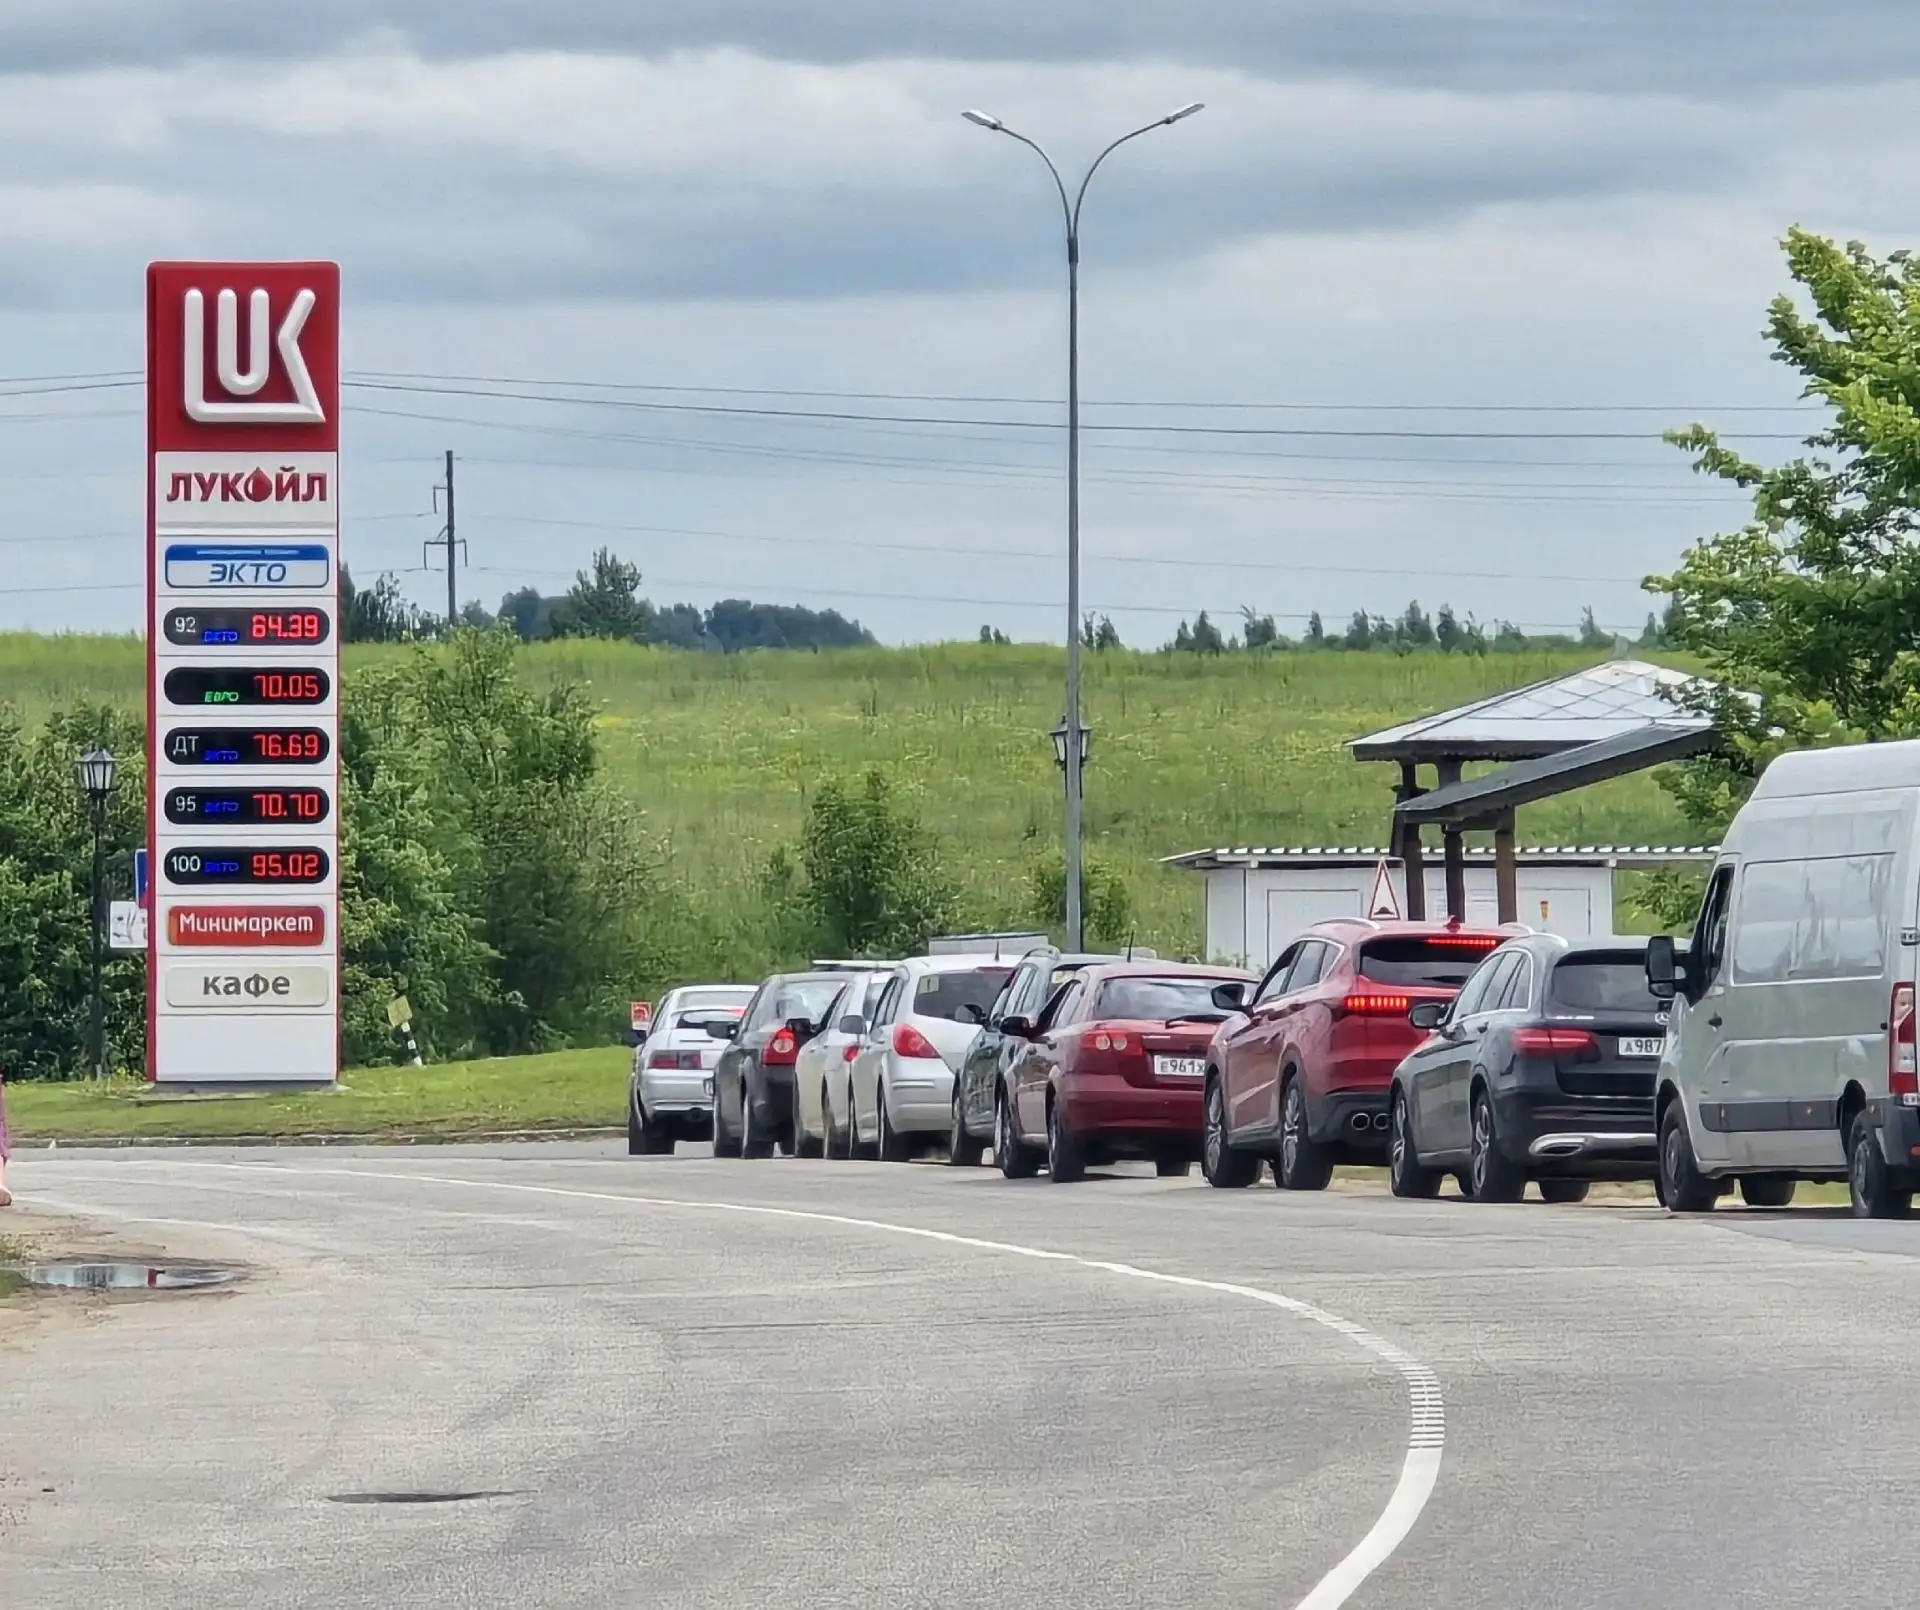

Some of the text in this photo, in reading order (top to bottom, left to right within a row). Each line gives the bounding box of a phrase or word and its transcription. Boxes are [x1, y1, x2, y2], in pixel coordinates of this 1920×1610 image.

[166, 466, 327, 502] ЛУКОЙЛ
[208, 563, 286, 583] ЭКТО
[174, 616, 196, 633] 92
[252, 615, 318, 637] 64.39
[253, 675, 319, 698] 70.05
[173, 736, 199, 756] ДТ
[253, 734, 319, 756] 76.69
[175, 796, 196, 812] 95
[252, 794, 319, 817] 70.70
[171, 855, 201, 872] 100
[252, 854, 319, 876] 95.02
[179, 913, 313, 938] Минимаркет
[203, 973, 290, 998] кафе
